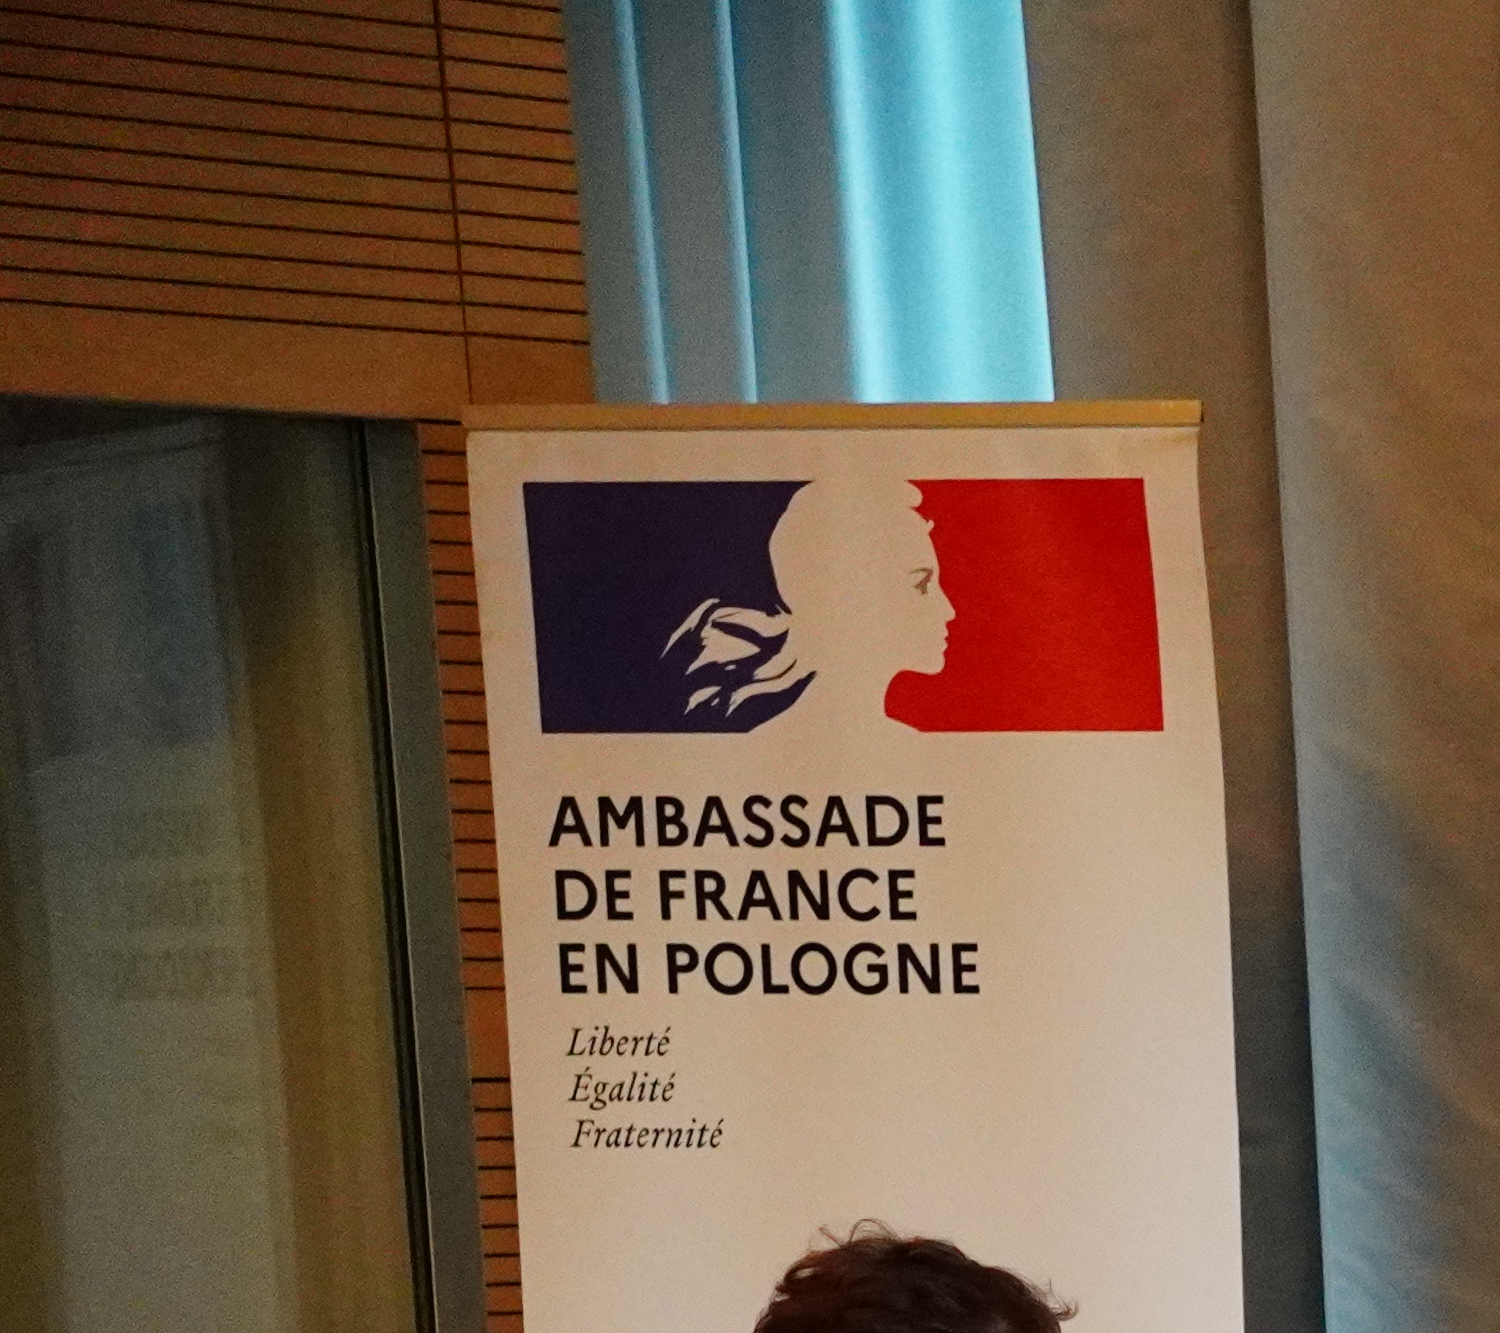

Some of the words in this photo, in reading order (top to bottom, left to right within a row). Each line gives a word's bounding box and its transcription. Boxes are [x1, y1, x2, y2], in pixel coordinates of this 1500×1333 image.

[549, 794, 946, 848] AMBASSADE
[555, 869, 634, 921] DE
[658, 867, 918, 922] FRANCE
[559, 942, 640, 994] EN
[666, 941, 981, 996] POLOGNE
[567, 1026, 671, 1057] Liberté
[569, 1067, 676, 1110] Égalité
[570, 1117, 724, 1149] Fraternité
